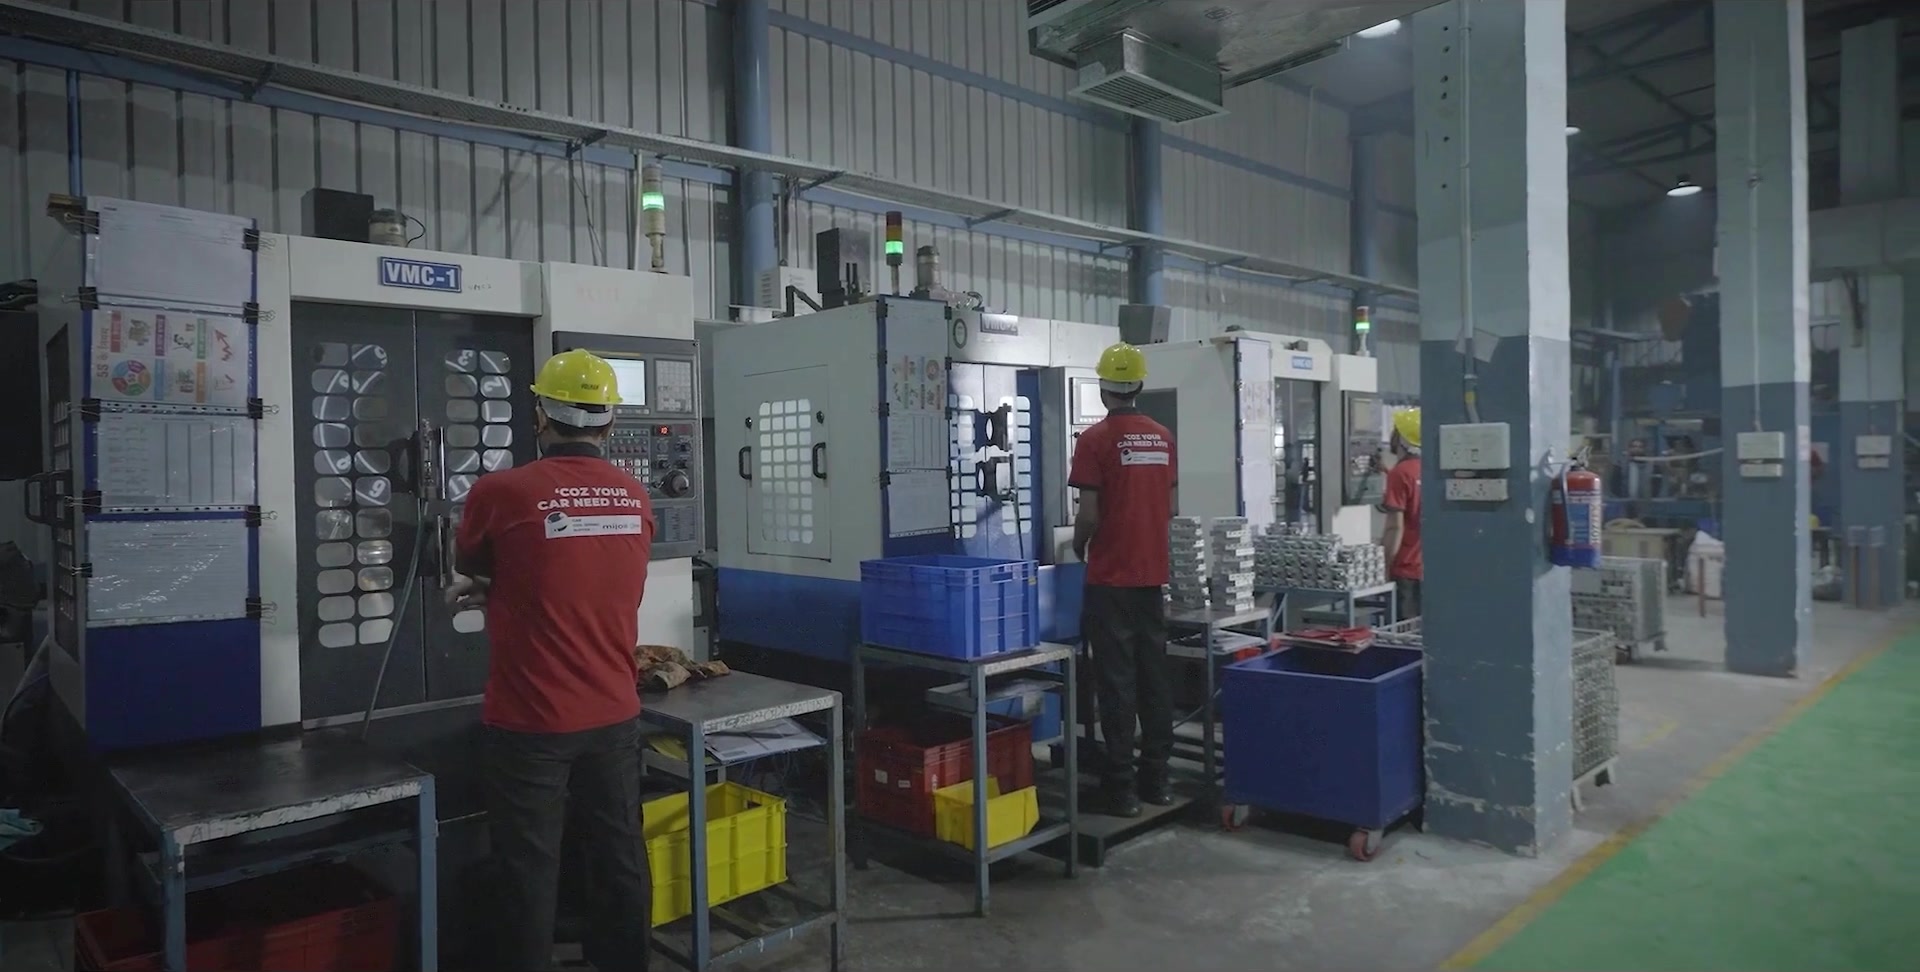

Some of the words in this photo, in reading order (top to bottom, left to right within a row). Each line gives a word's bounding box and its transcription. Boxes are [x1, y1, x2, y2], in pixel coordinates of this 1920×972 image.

[385, 261, 457, 288] VMC-1
[555, 487, 590, 497] 'COZ
[592, 487, 628, 497] YOUR
[537, 498, 570, 511] CAR
[573, 497, 611, 508] NEED
[614, 498, 642, 509] LOVE
